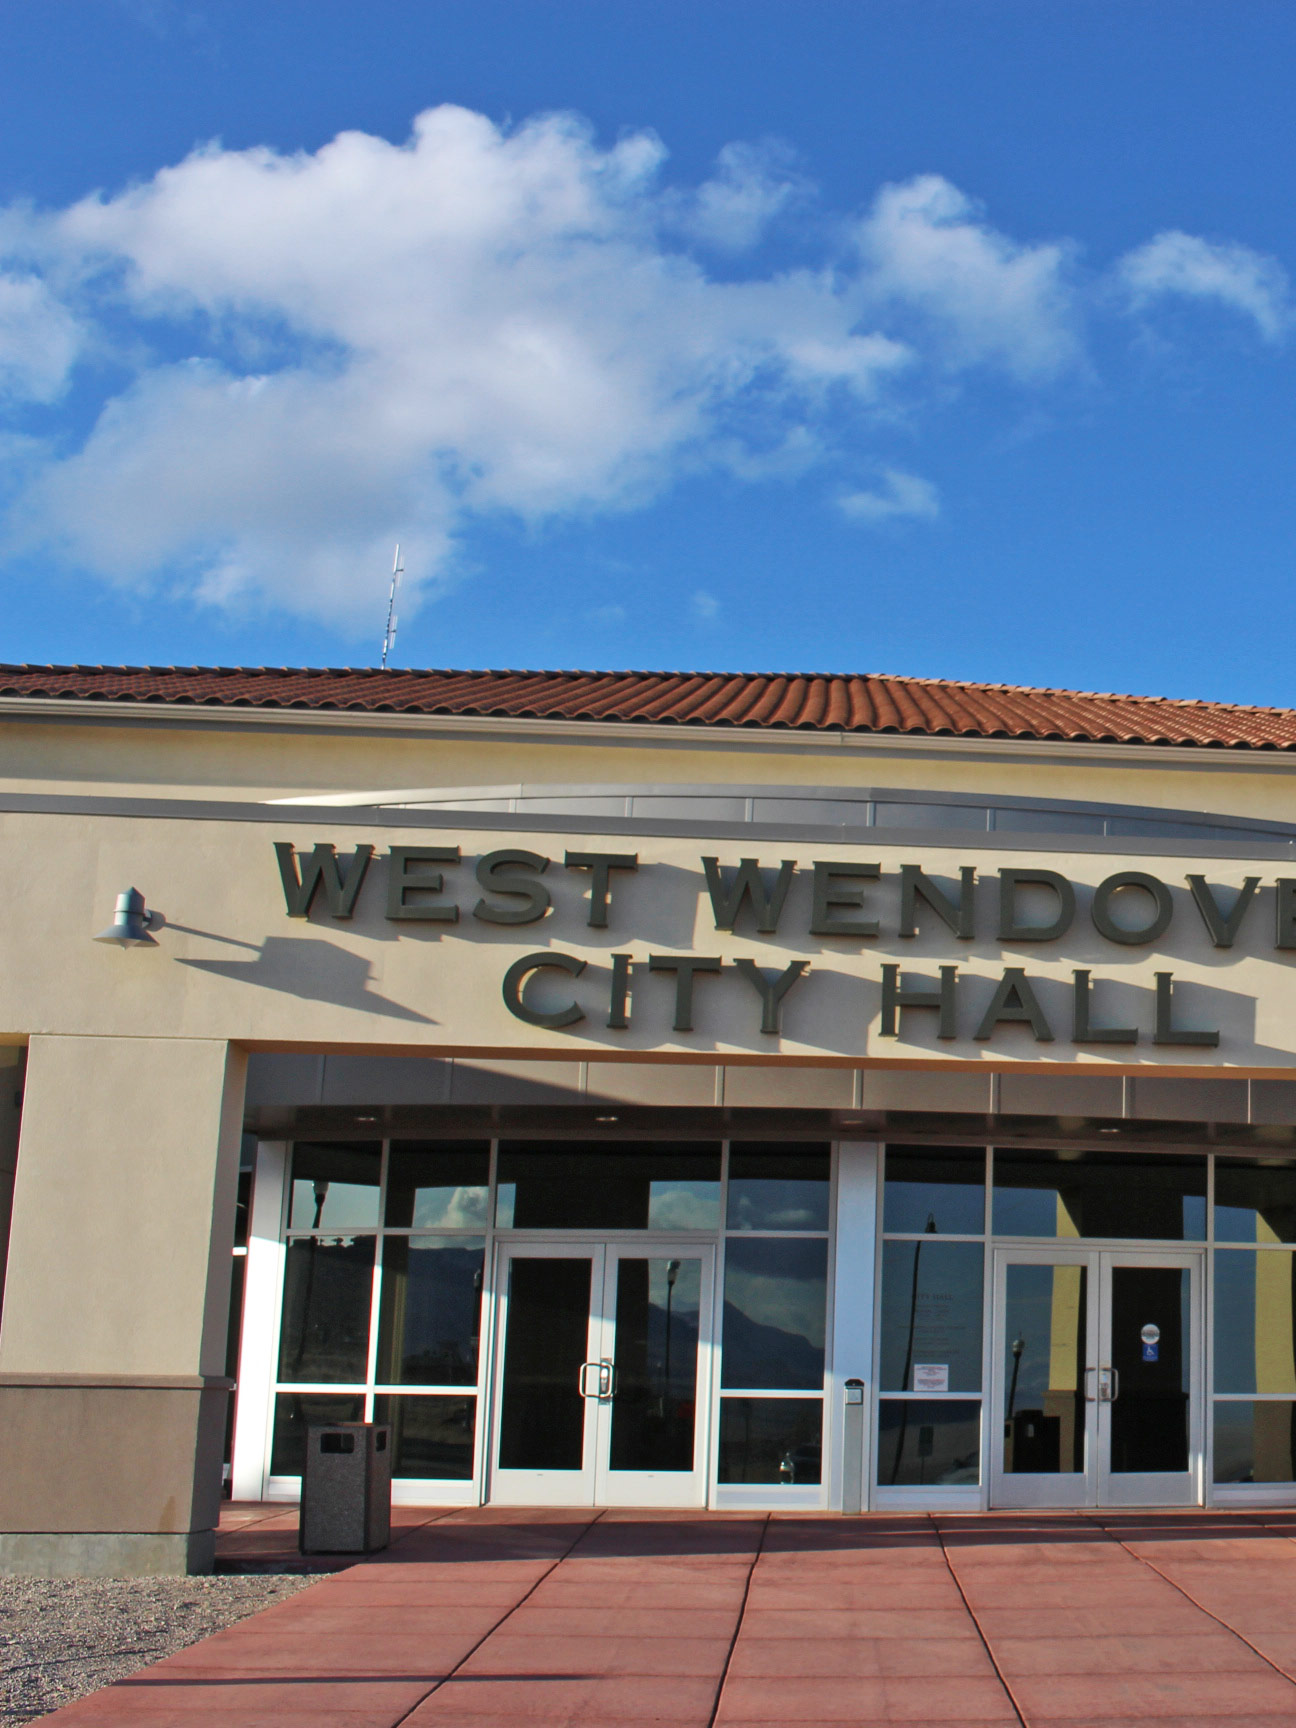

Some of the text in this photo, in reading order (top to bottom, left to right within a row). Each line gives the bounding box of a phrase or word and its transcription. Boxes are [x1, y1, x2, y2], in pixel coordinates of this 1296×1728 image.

[274, 842, 638, 928] WEST
[502, 951, 1220, 1048] CITY HALL
